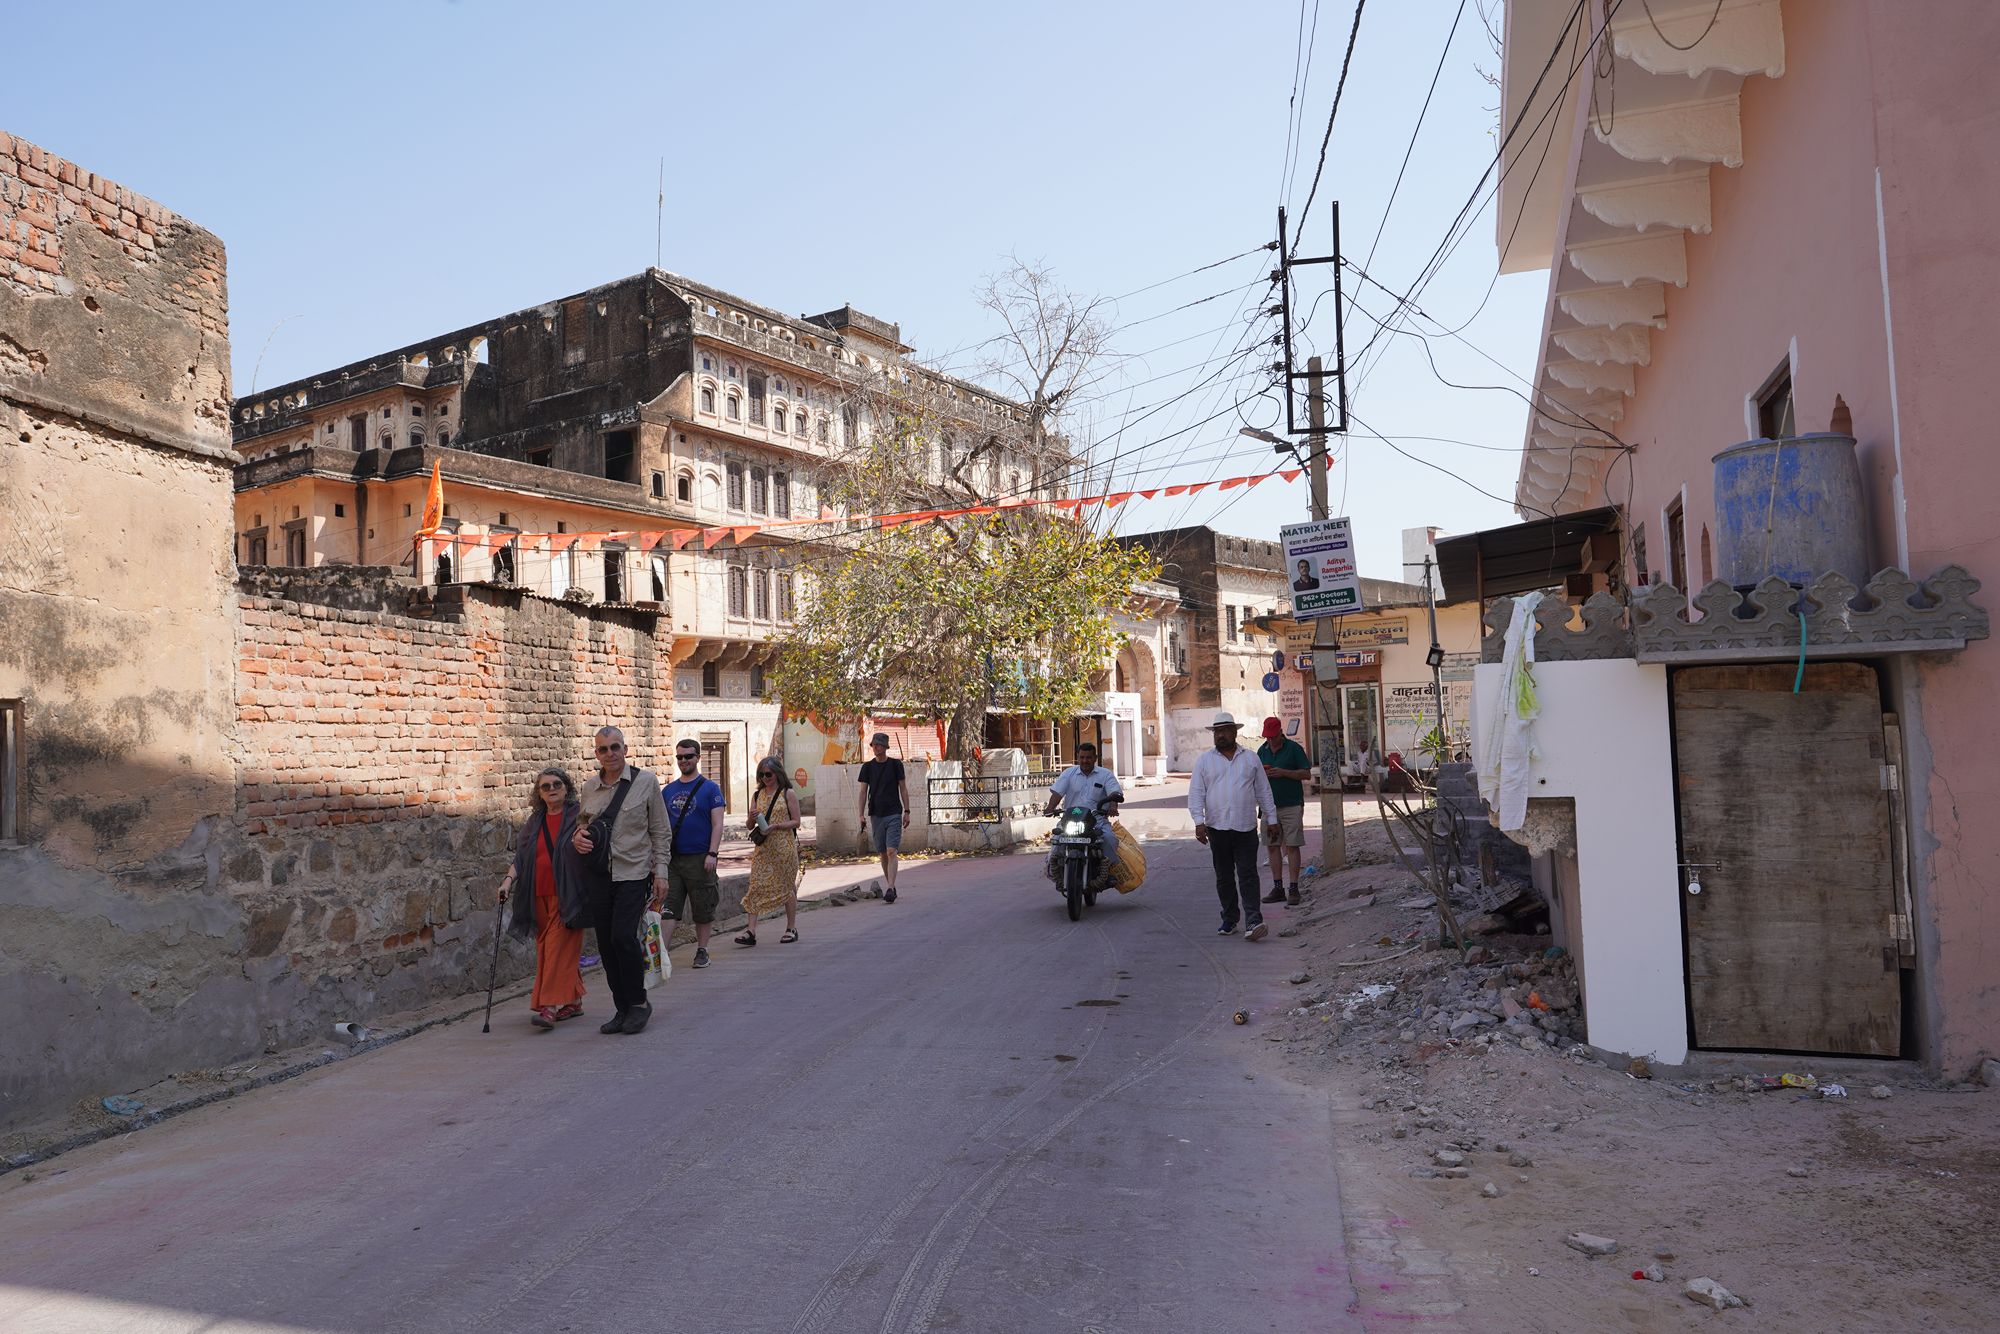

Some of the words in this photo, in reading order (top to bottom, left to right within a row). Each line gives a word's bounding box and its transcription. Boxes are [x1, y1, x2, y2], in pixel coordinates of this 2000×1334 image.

[1282, 526, 1320, 537] MATRIX
[1323, 520, 1348, 531] NEET
[1327, 558, 1346, 566] Aditya
[1321, 565, 1353, 574] Ramgarhia
[1309, 600, 1325, 608] Last
[1331, 597, 1351, 605] Years
[1392, 686, 1423, 698] वाहन
[787, 743, 818, 753] MANGO
